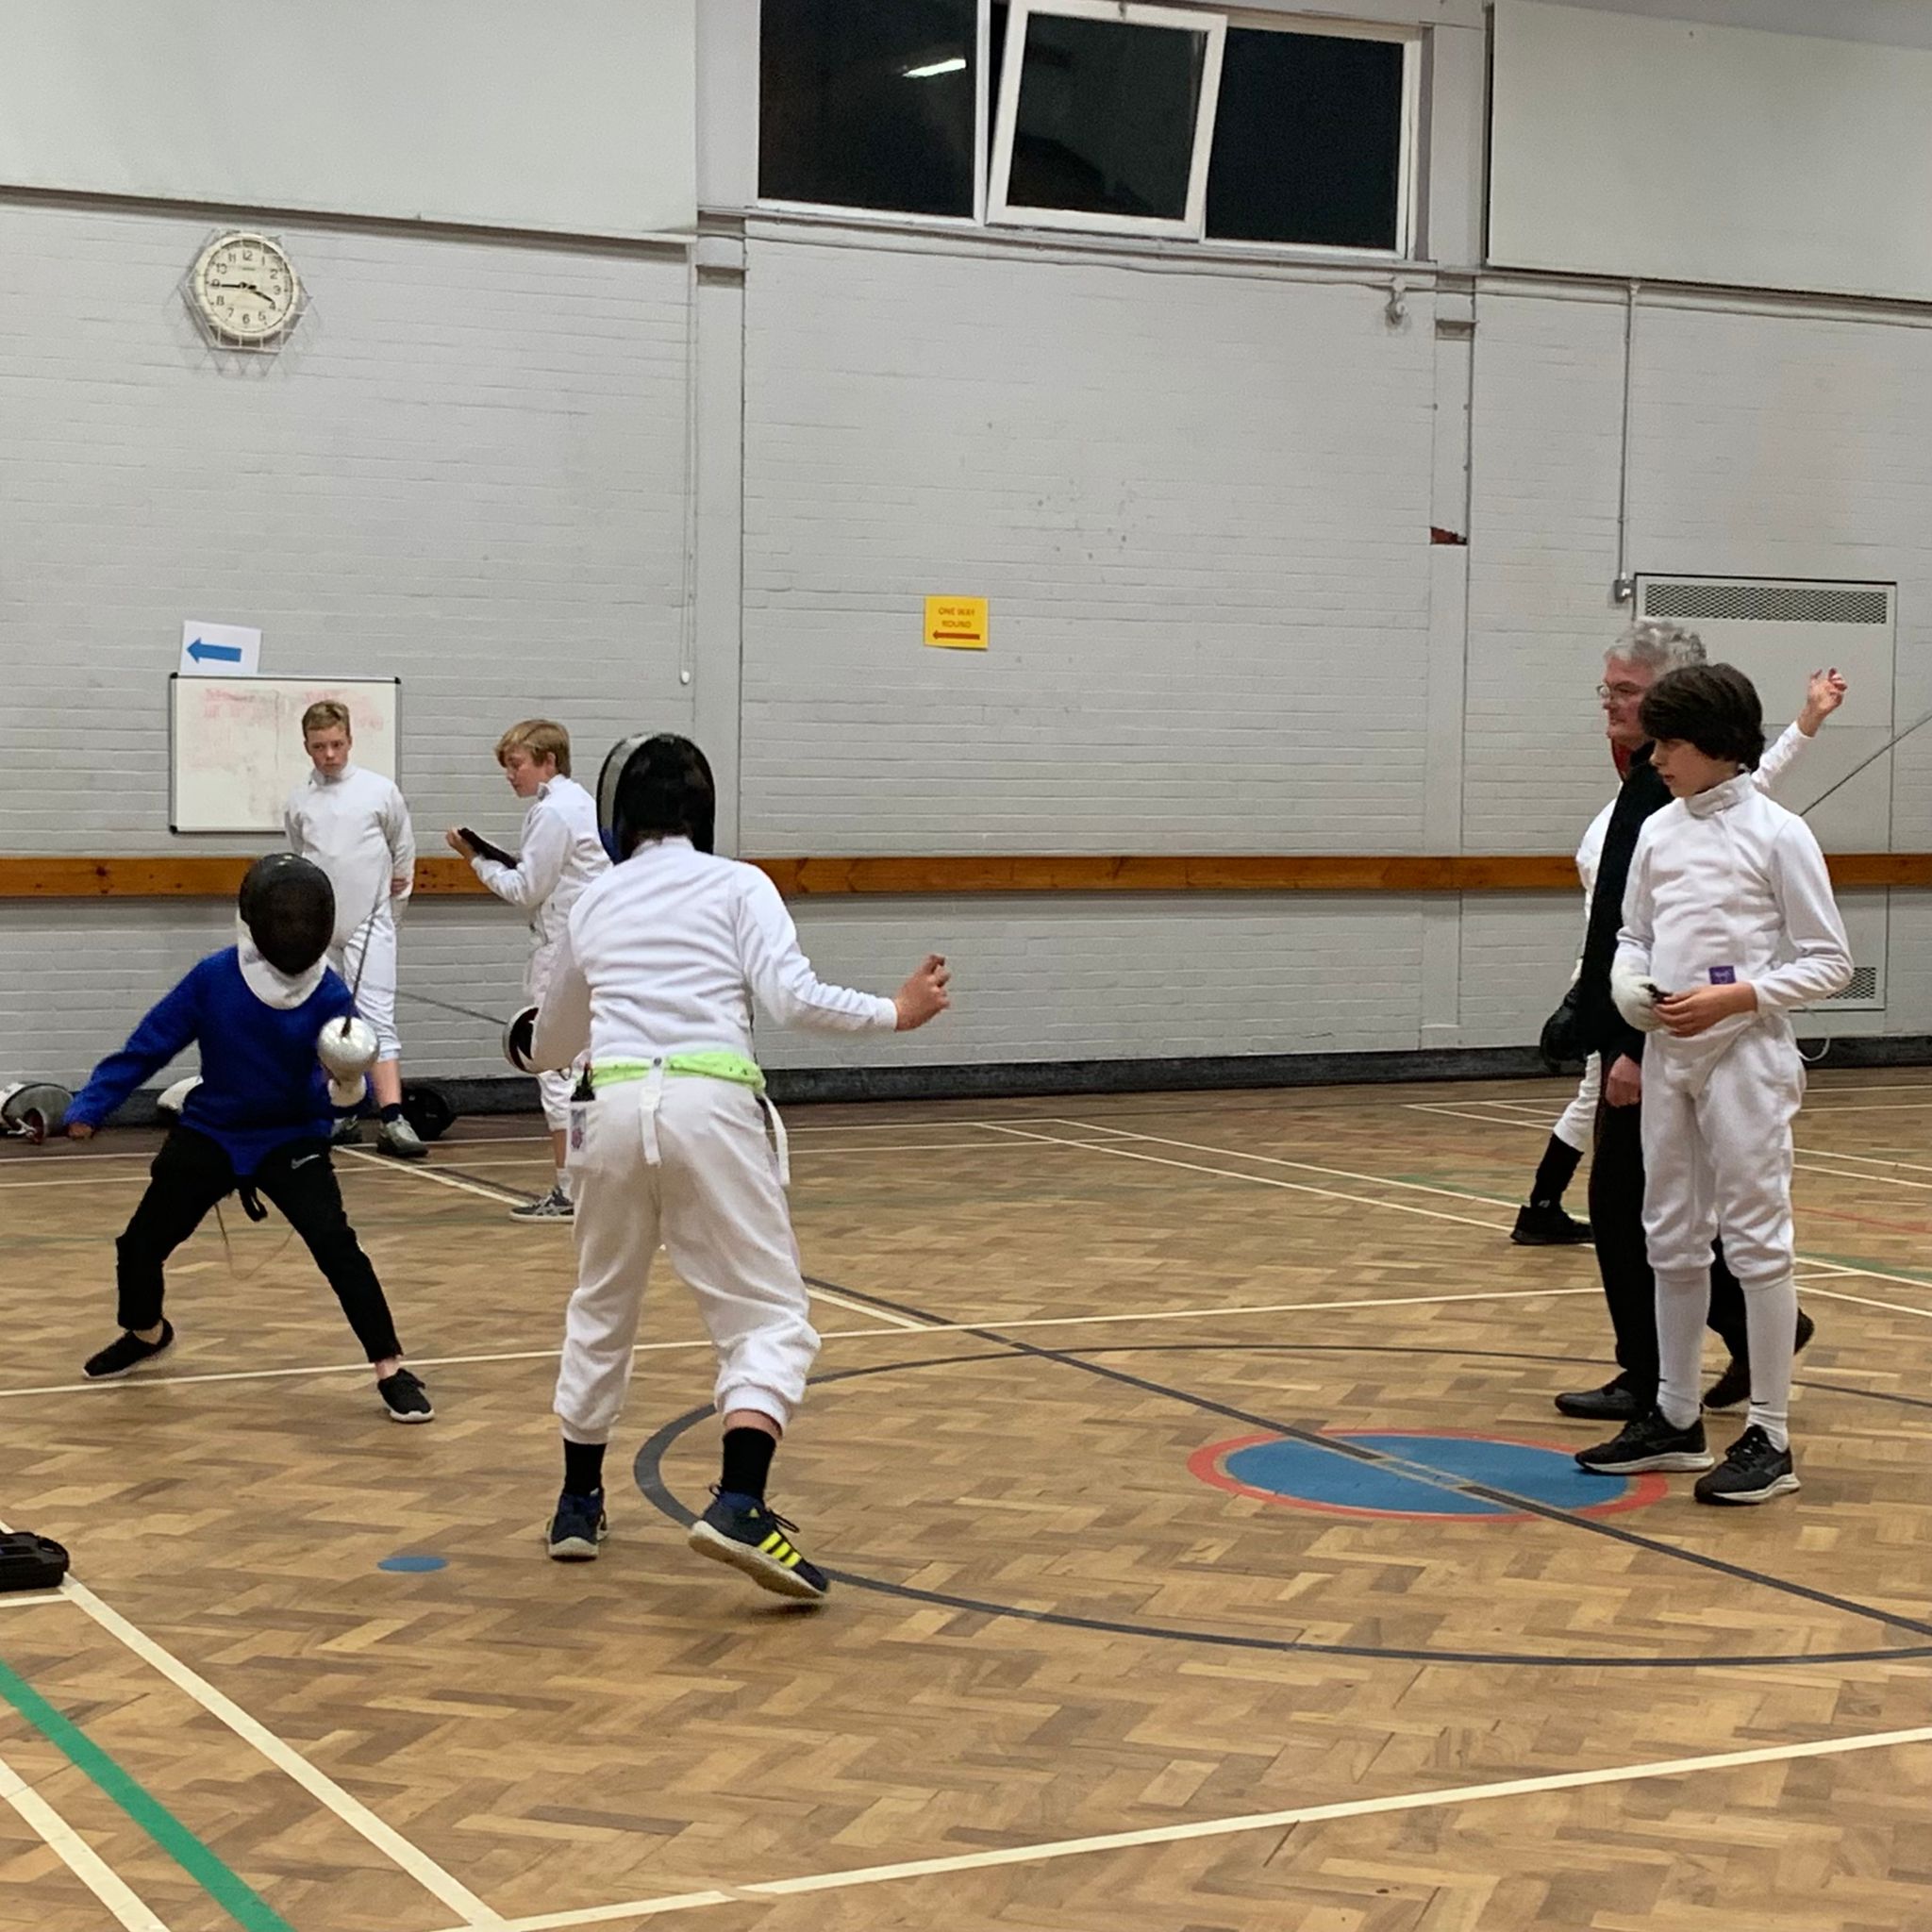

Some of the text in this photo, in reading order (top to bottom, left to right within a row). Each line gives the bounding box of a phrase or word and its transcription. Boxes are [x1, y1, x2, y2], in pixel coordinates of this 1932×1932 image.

[228, 253, 237, 262] 11
[242, 250, 253, 261] 12
[216, 263, 227, 275] 10
[270, 268, 278, 279] 2
[274, 285, 281, 295] 3
[216, 295, 225, 306] 8
[227, 308, 234, 317] 7
[258, 310, 266, 321] 5
[242, 313, 250, 325] 6
[938, 607, 975, 617] ONE WAY
